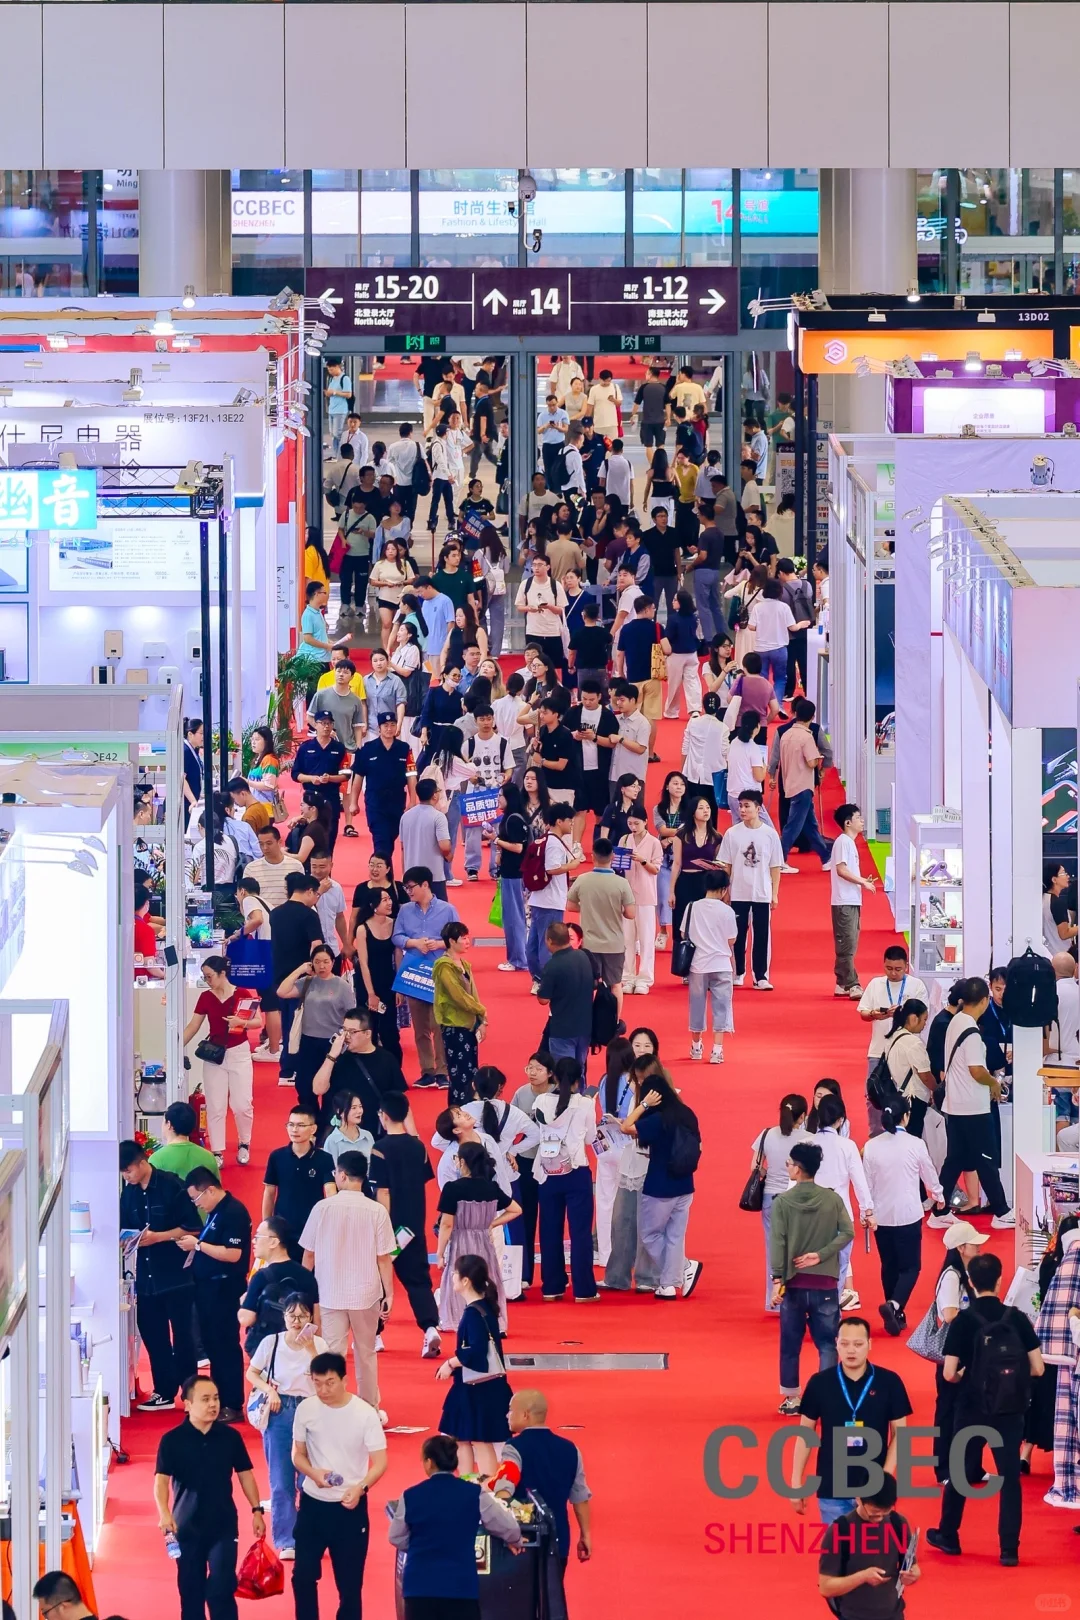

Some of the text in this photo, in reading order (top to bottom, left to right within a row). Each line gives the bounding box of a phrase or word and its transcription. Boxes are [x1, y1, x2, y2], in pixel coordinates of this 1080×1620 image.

[233, 200, 295, 215] CCBEC
[441, 218, 476, 227] Fashion
[529, 219, 546, 227] Hall
[374, 275, 440, 300] 15-20
[643, 275, 689, 300] 1-12
[530, 287, 561, 315] 14
[512, 307, 527, 315] Hall
[354, 317, 394, 327] North Lobby
[1018, 312, 1050, 322] 13D02
[647, 318, 689, 328] South Lobby
